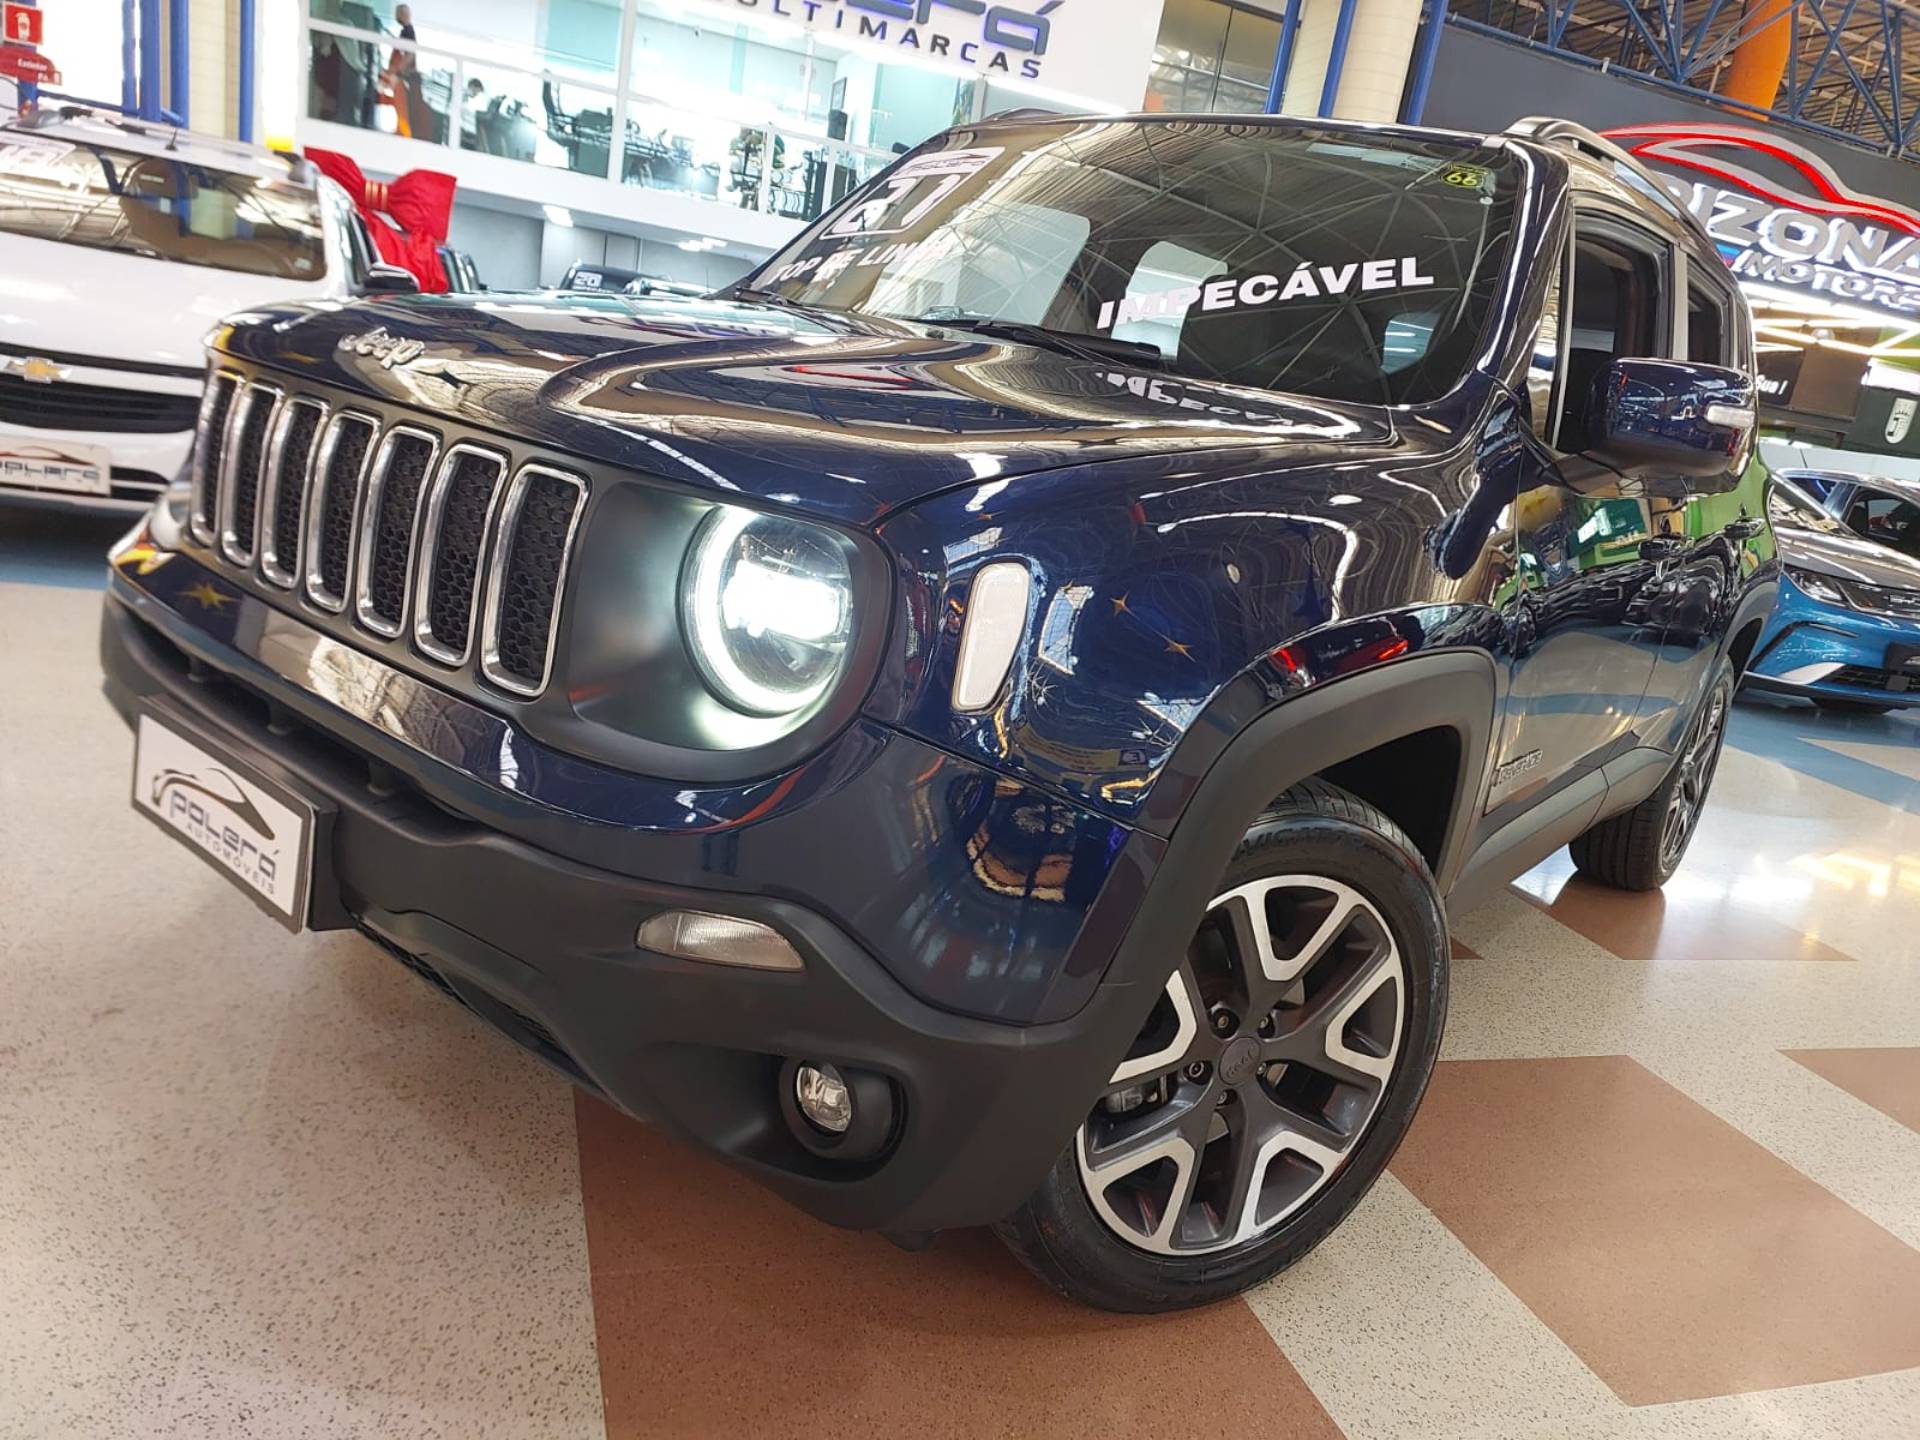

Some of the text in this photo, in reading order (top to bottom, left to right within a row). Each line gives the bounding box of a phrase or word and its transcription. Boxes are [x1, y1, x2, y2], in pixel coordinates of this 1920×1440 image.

[1446, 172, 1478, 186] 66
[768, 256, 823, 285] TOP
[1096, 256, 1435, 330] IMPECÁVEL
[337, 326, 425, 370] Jeep
